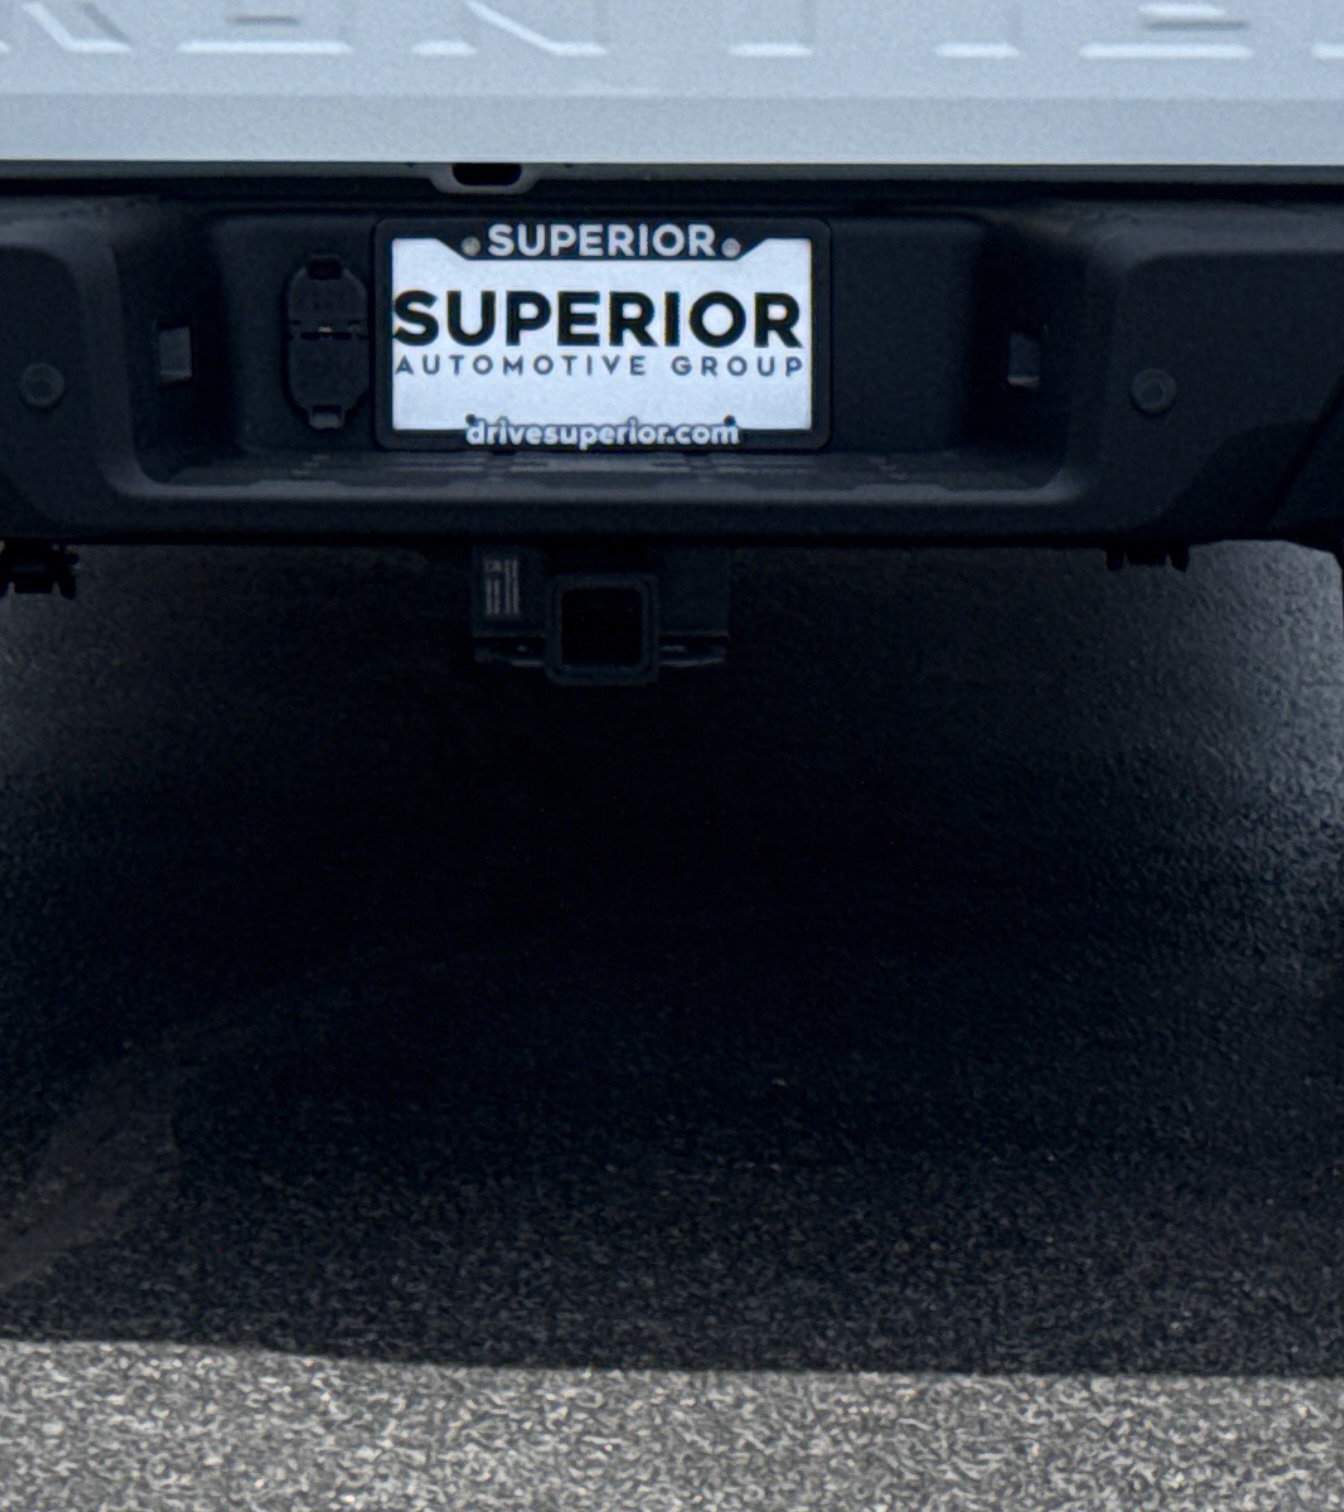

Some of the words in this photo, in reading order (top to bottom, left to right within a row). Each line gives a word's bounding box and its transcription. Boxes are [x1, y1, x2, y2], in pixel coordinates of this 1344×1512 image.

[487, 223, 716, 258] SUPERIOR
[394, 289, 804, 349] SUPERIOR
[395, 354, 647, 377] AUTOMOTIVE
[671, 355, 804, 378] GROUP
[465, 417, 740, 451] drivesuperior.com
